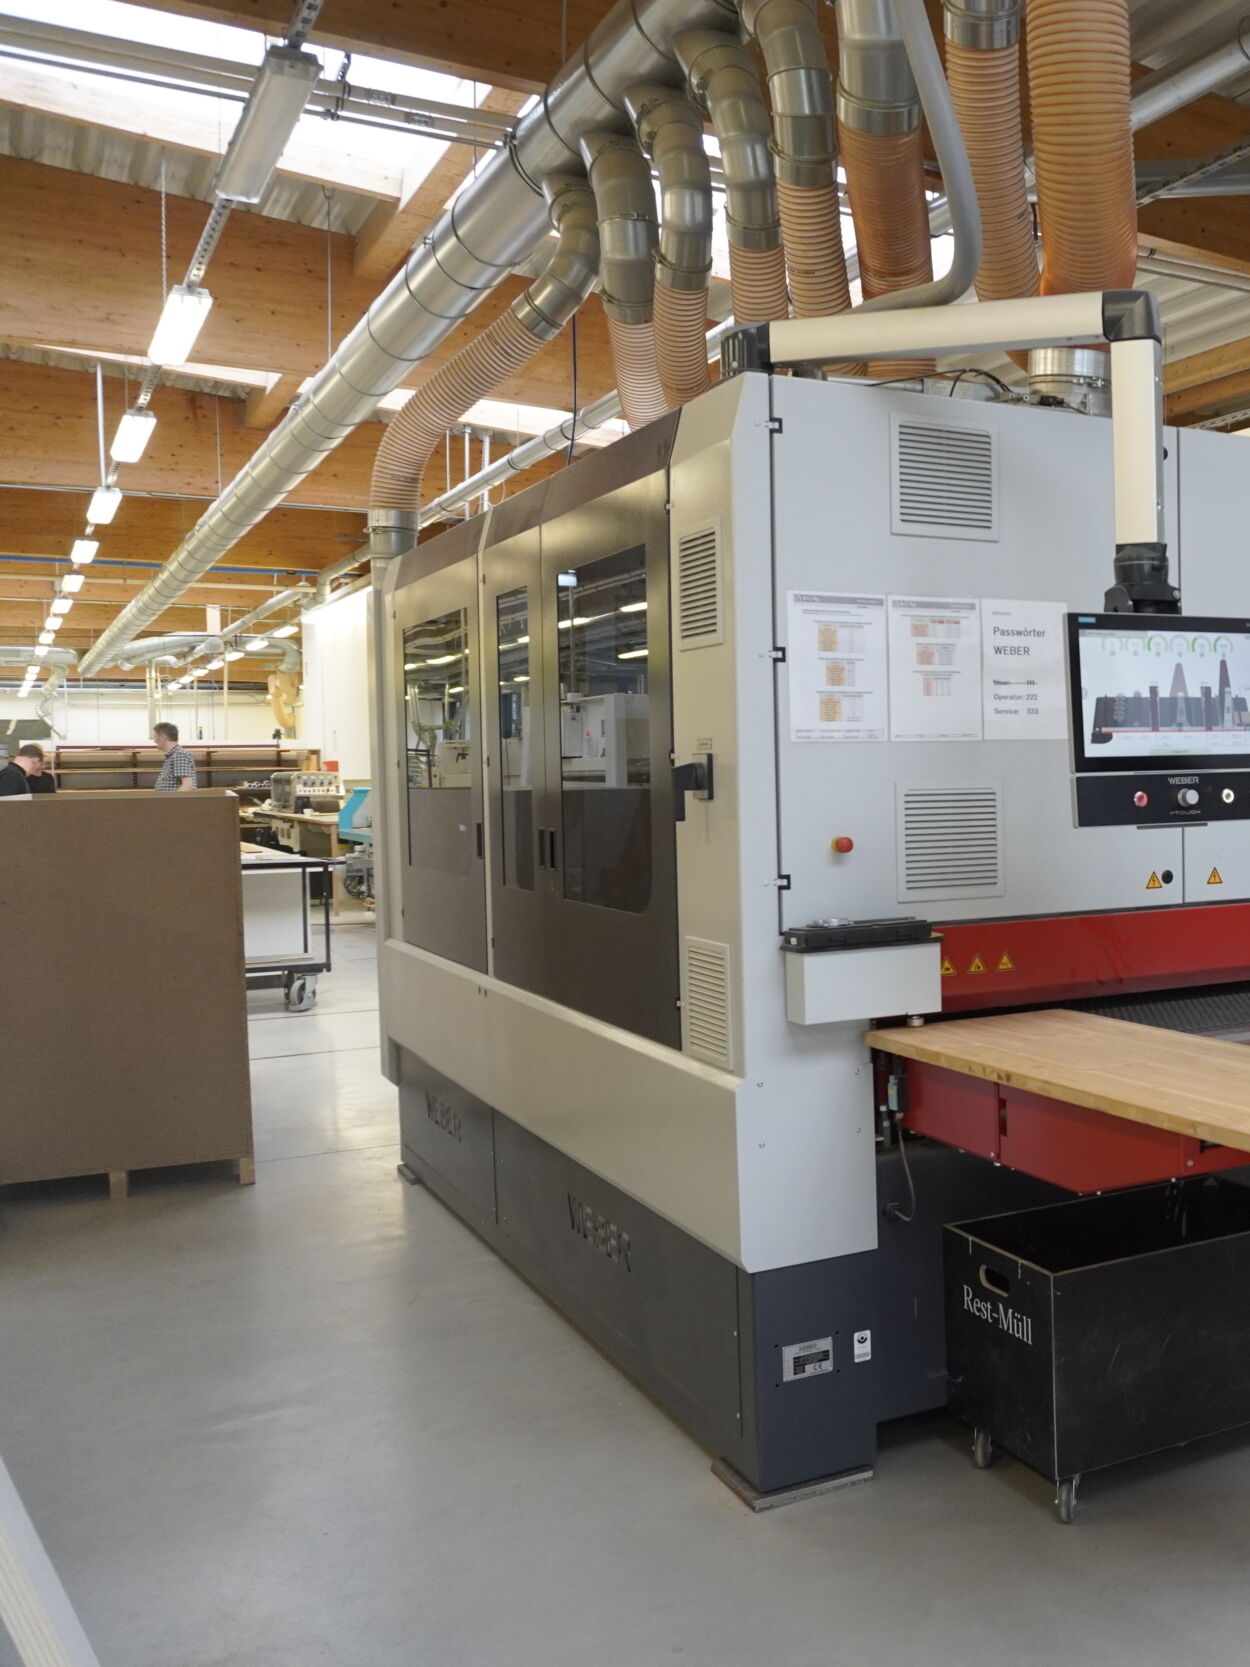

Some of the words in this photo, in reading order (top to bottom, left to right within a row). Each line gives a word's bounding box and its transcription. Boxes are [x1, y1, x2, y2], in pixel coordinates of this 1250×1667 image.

[993, 626, 1046, 638] Passwörter
[993, 645, 1030, 656] WEBER
[1168, 776, 1200, 785] WEBER
[963, 1283, 1033, 1346] Rest-Müll
